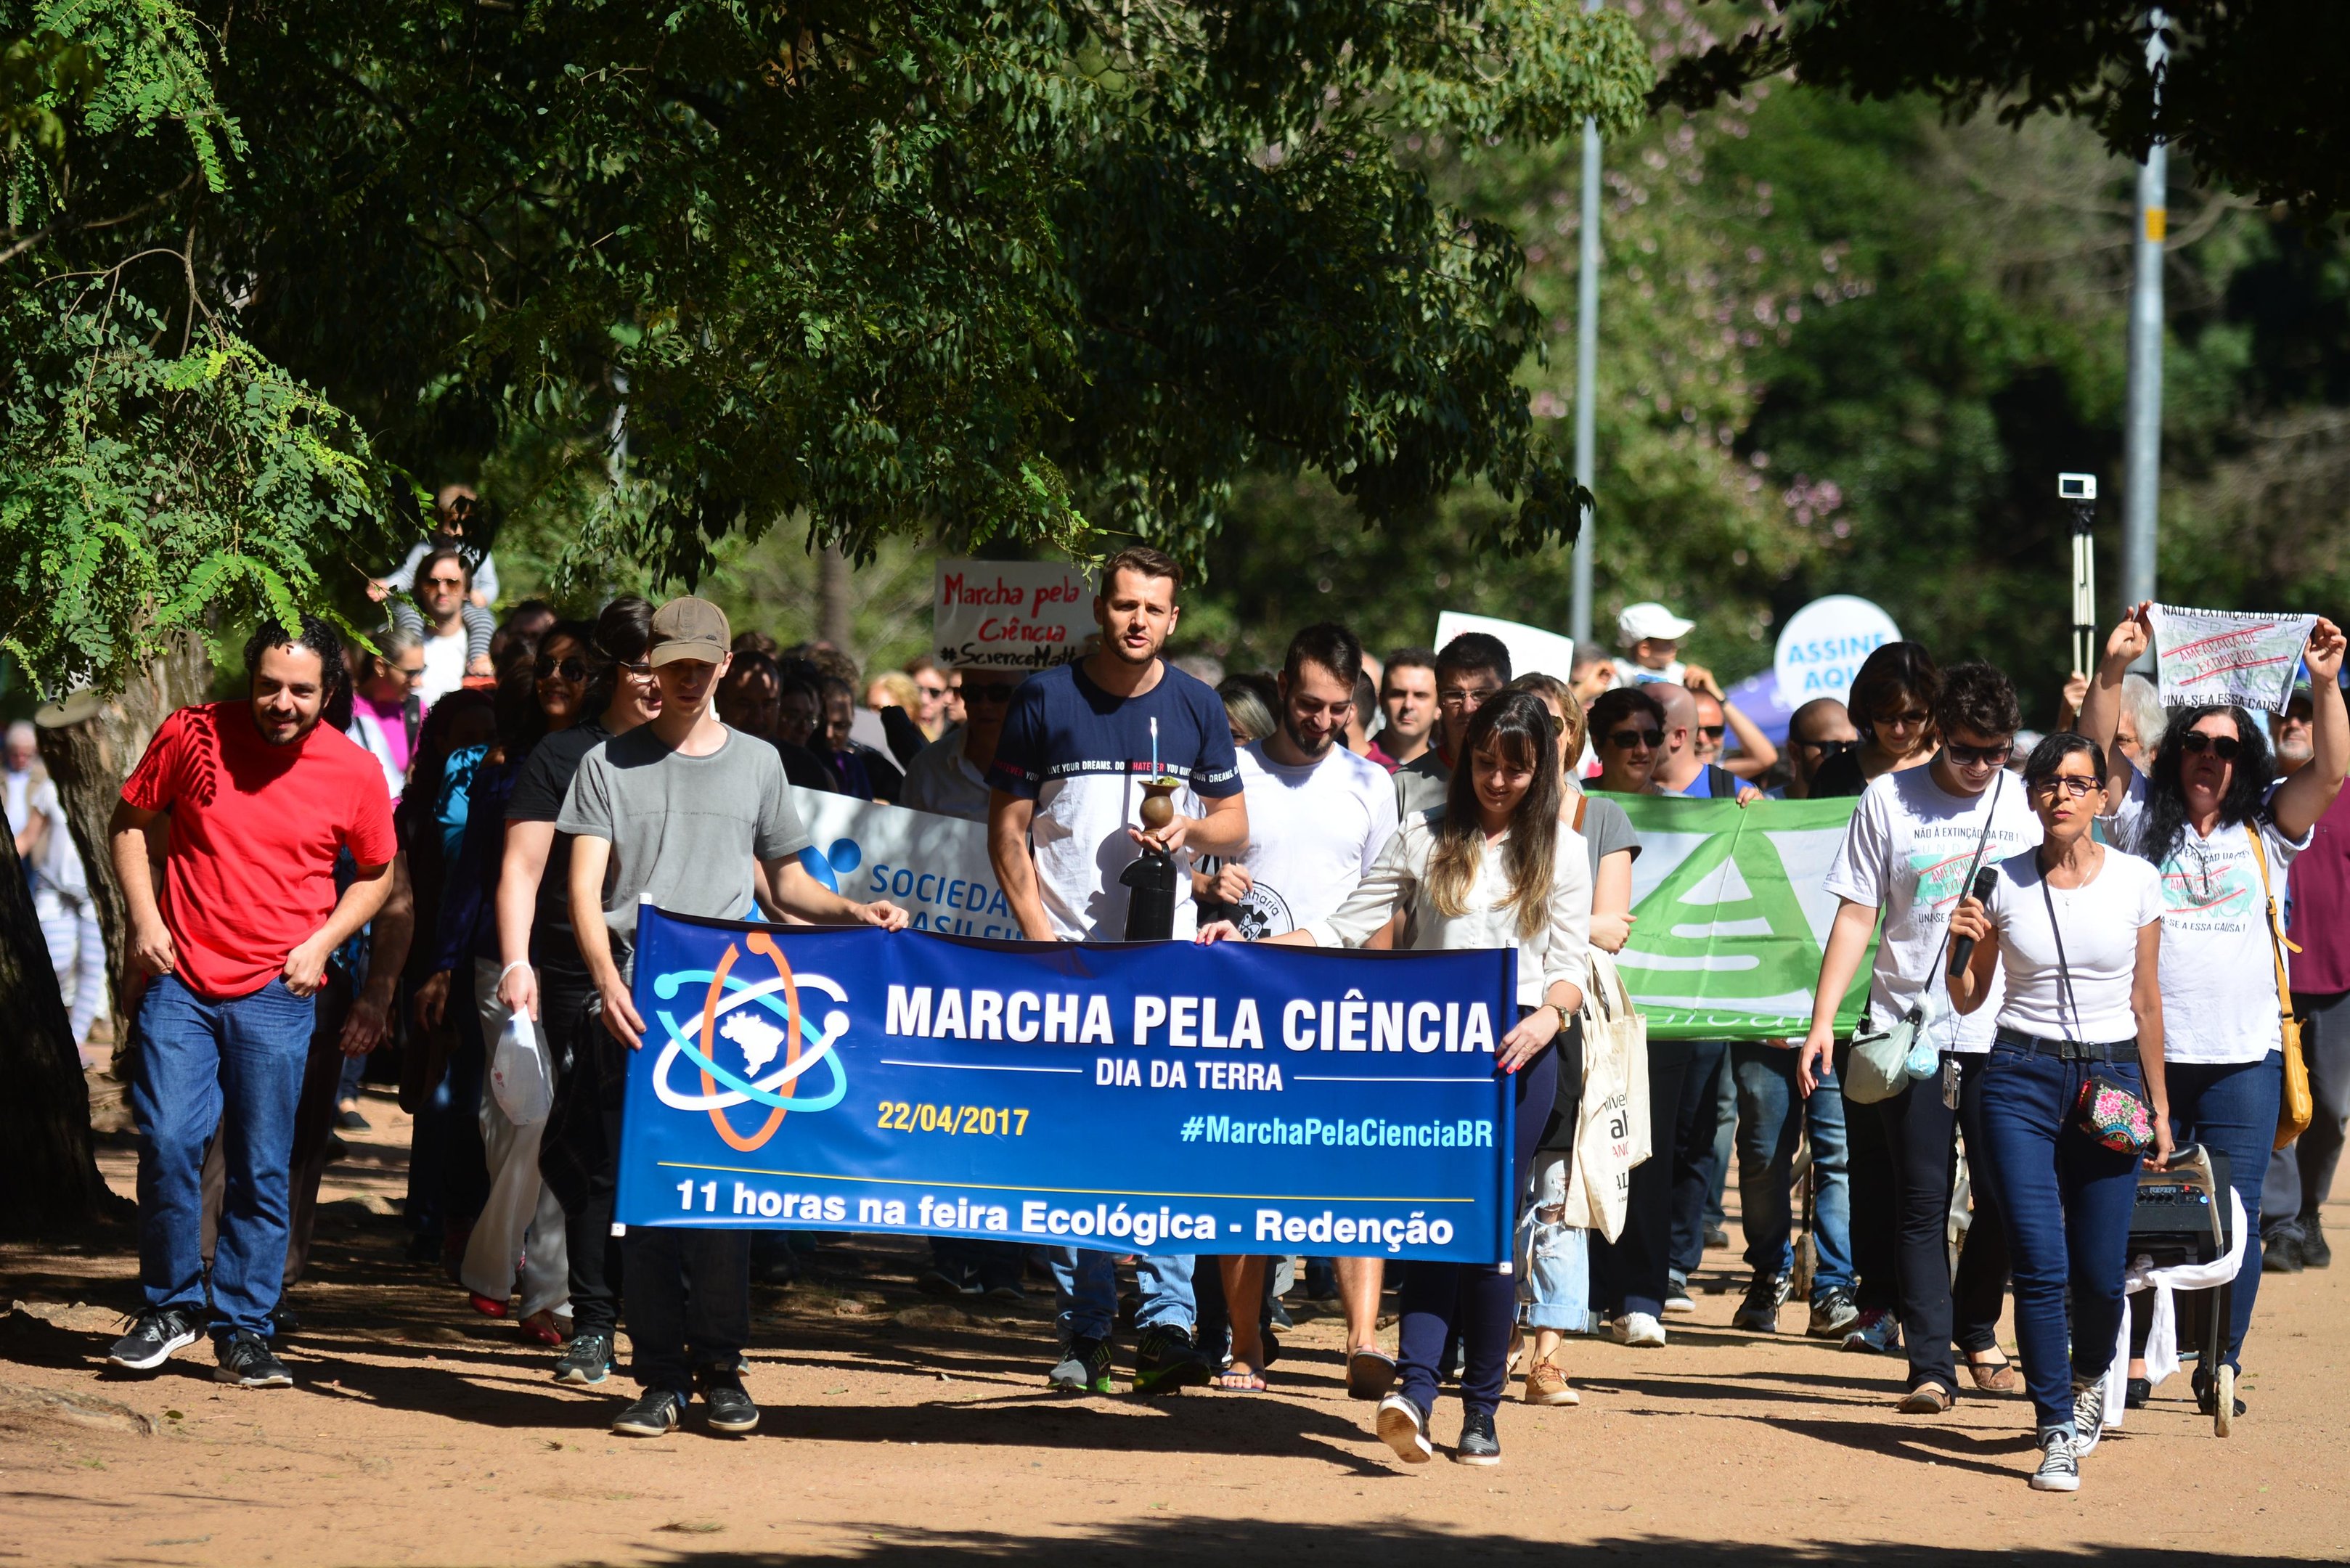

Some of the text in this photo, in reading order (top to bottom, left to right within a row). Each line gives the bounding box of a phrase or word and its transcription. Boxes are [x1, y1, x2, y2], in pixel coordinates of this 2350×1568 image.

[944, 572, 1080, 618] Marcha pela
[978, 617, 1066, 643] Ciência
[2217, 693, 2245, 708] ESSA
[1026, 771, 1040, 782] YOU
[1047, 764, 1060, 775] LIVE
[1061, 761, 1080, 772] YOUR
[1082, 760, 1112, 770] DREAMS.
[1114, 761, 1125, 771] DO
[1167, 764, 1178, 774] YOU
[1193, 770, 1206, 783] OUR
[1914, 828, 1931, 839] NÃO
[1943, 826, 1983, 840] EXTINÇÃO
[1999, 830, 2014, 841] FZB
[870, 865, 1014, 920] SOCIEDA
[885, 984, 1496, 1053] MARCHA PELA CIÊNCIA
[1096, 1058, 1283, 1092] DIA DA TERRA
[877, 1101, 1029, 1136] 22/04/2017
[1180, 1115, 1493, 1147] #MarchaPelaCienciaBR
[676, 1179, 1453, 1254] 11 horas na feira Ecológica - Redenção
